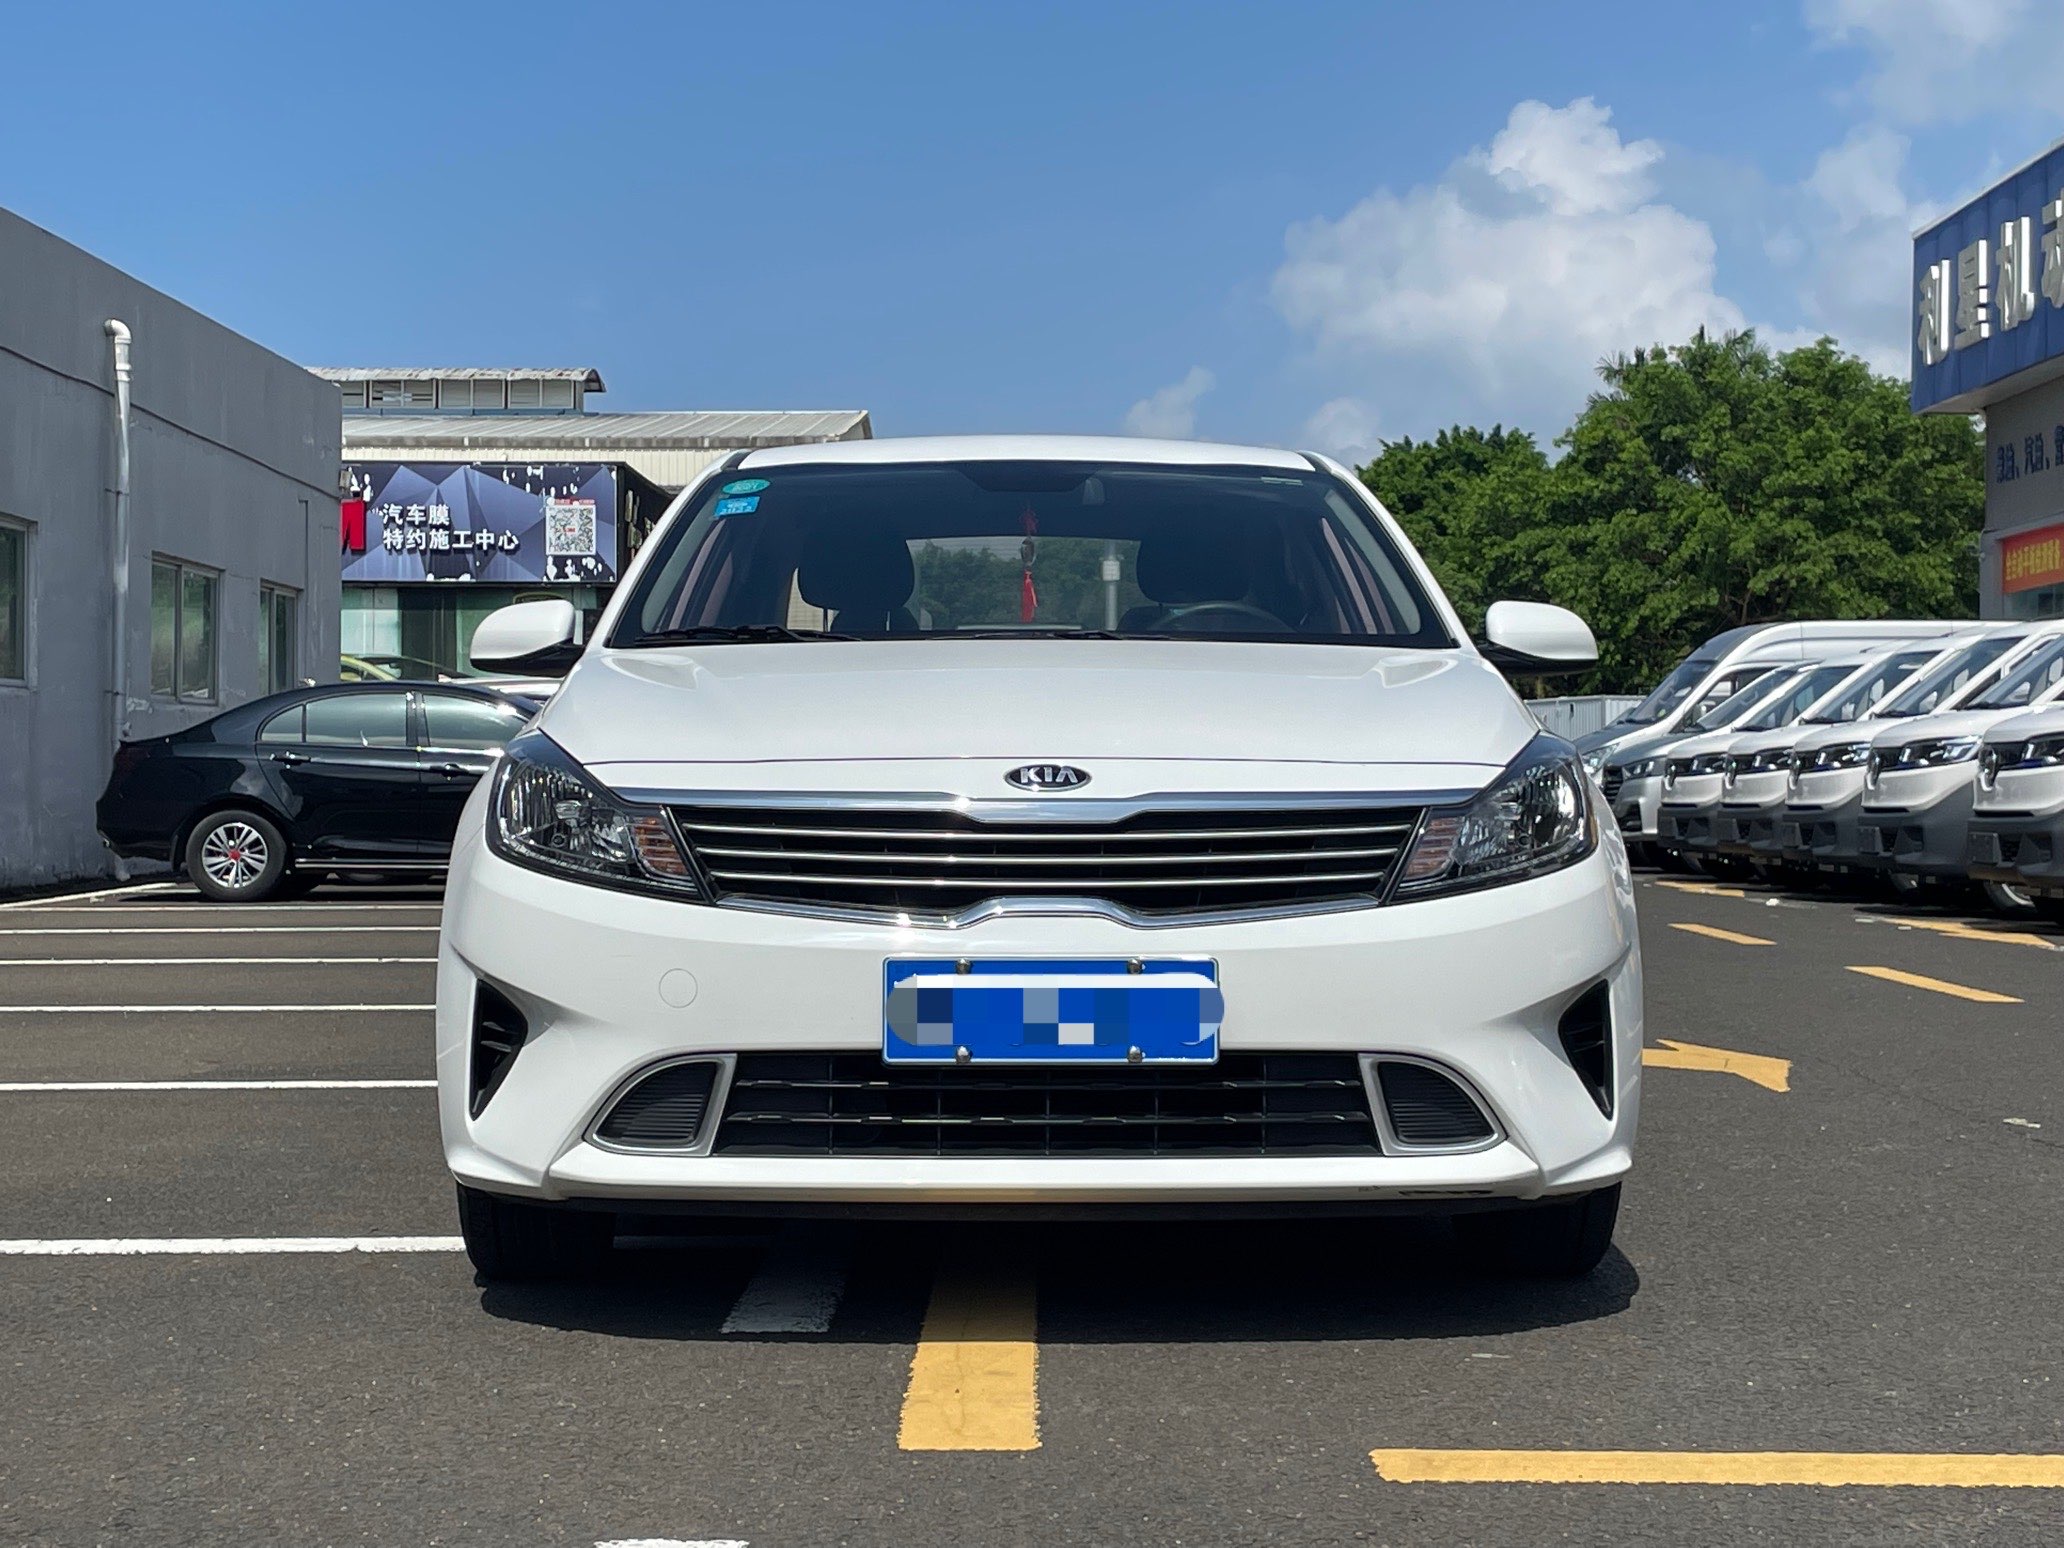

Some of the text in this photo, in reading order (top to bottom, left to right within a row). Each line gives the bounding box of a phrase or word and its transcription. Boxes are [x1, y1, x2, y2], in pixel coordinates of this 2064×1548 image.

[382, 503, 450, 526] 汽车膜
[382, 528, 519, 551] 特约施工中心
[1019, 766, 1079, 784] KIA
